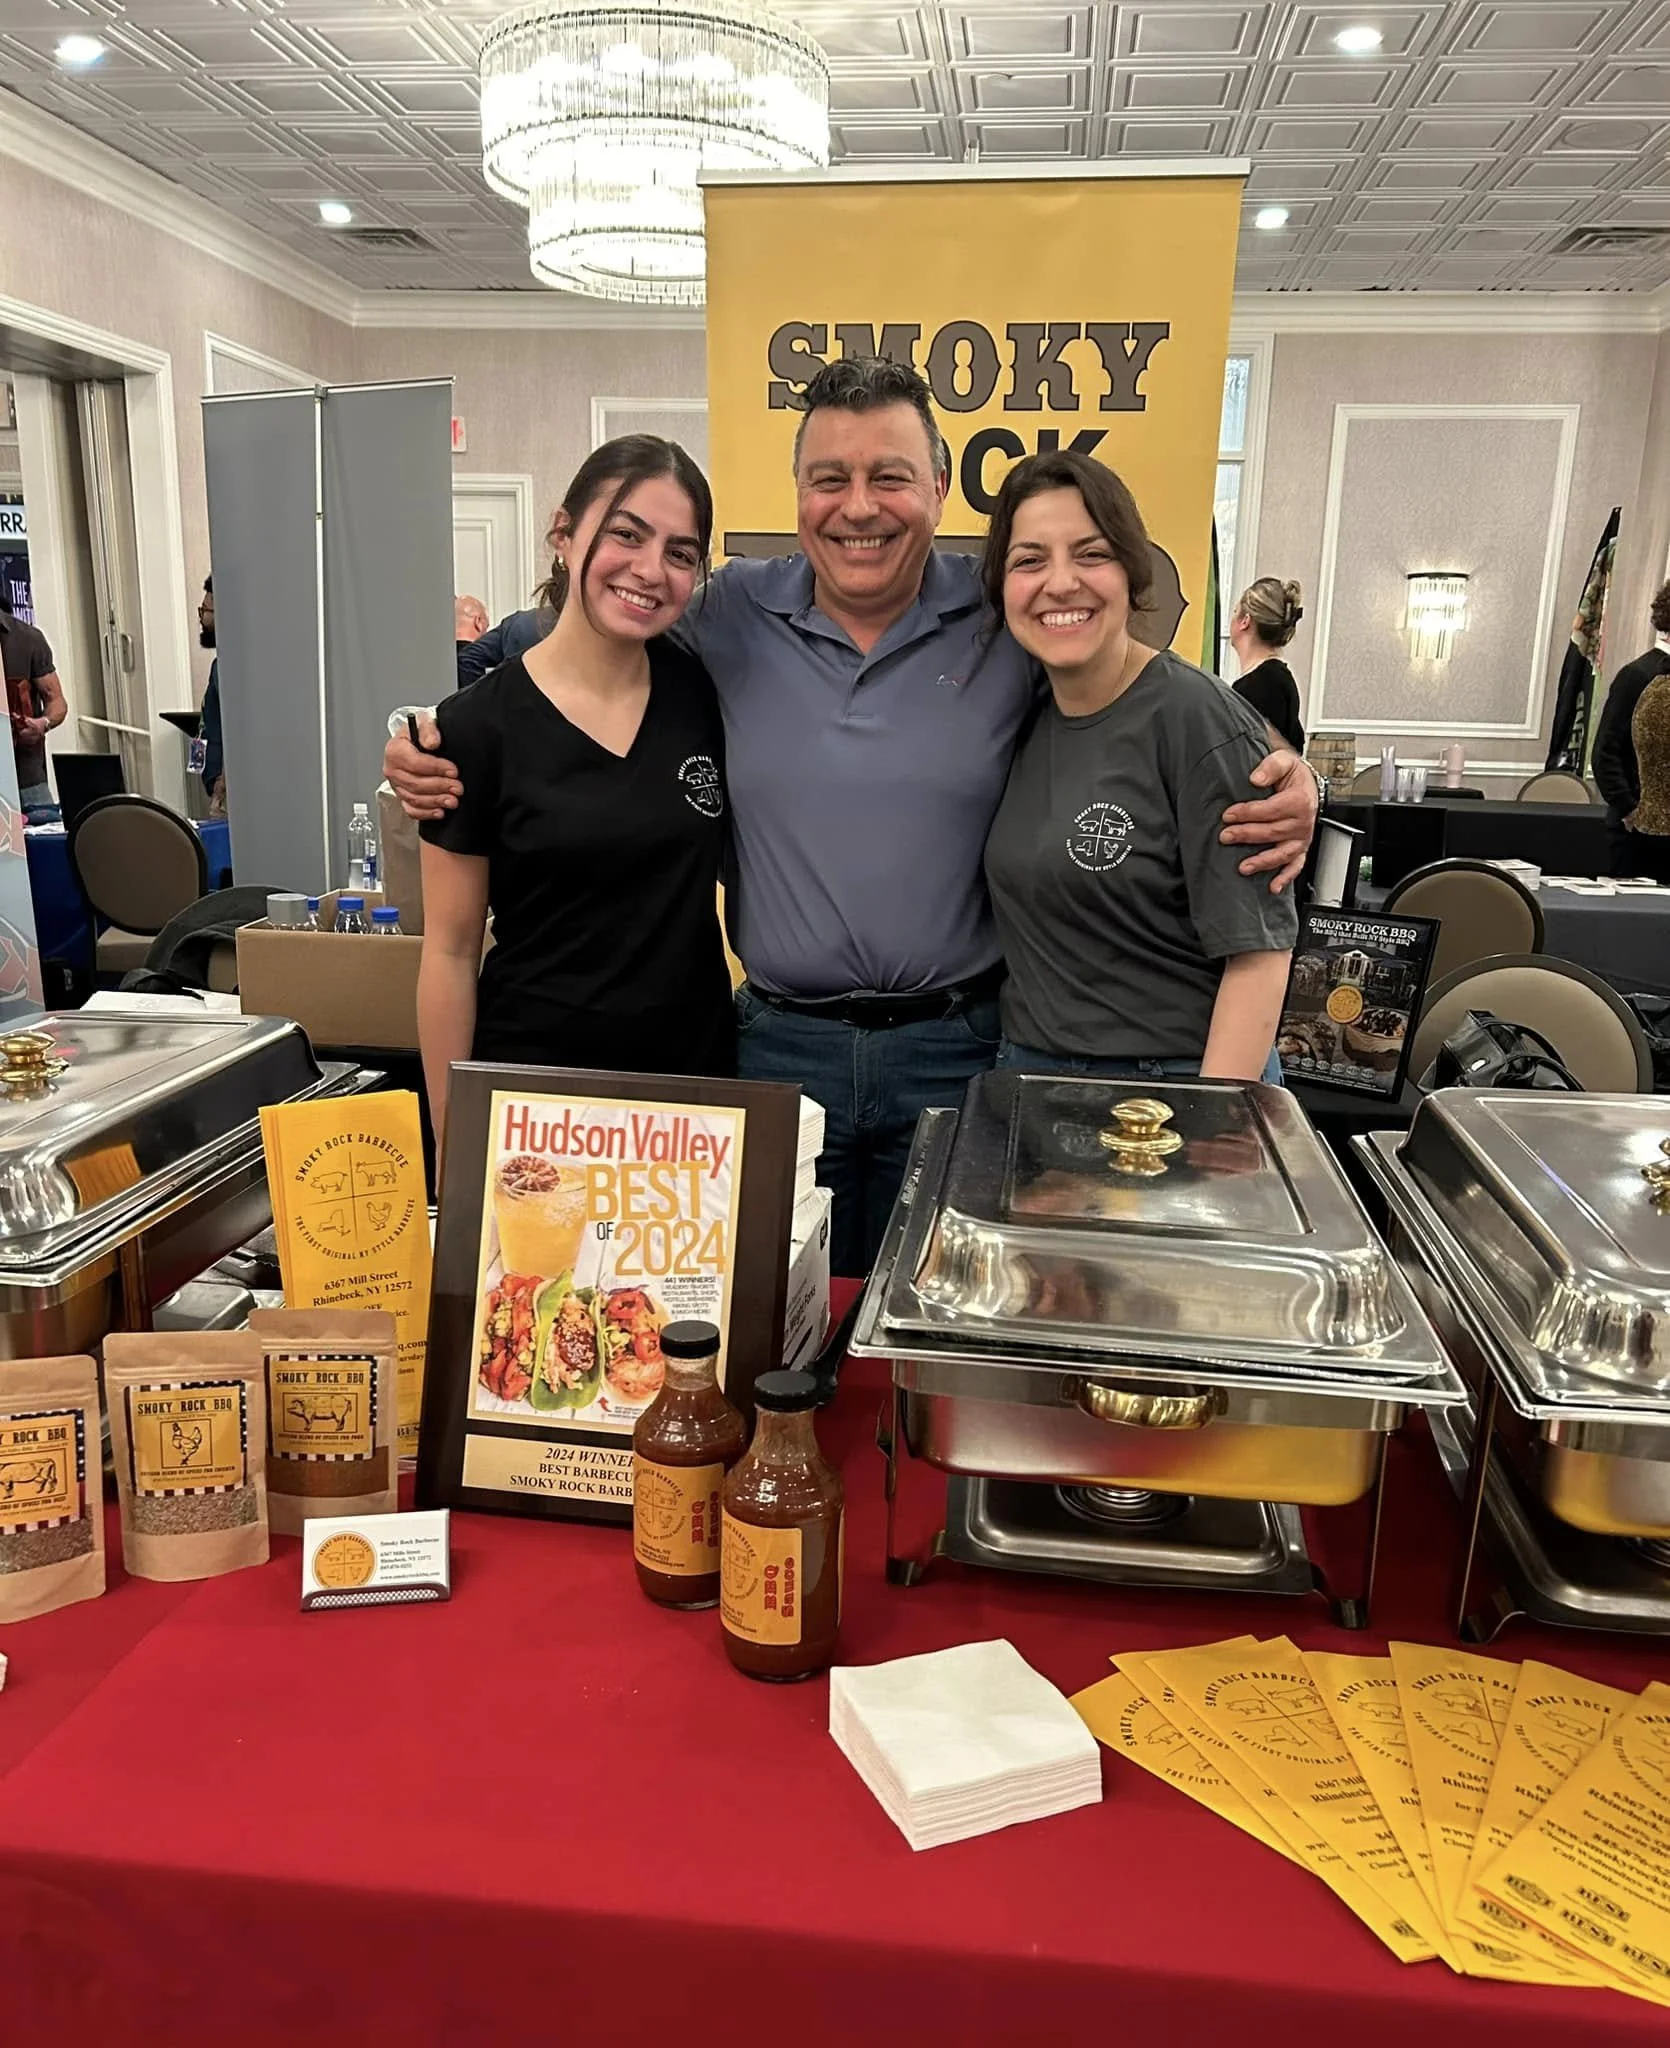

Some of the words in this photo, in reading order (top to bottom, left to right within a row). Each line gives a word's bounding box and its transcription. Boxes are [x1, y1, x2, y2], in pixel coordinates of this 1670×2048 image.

[0, 512, 27, 533] RR
[10, 580, 28, 605] THE
[1309, 917, 1353, 931] SMOKY
[1354, 922, 1389, 936] ROCK
[1390, 927, 1417, 941] BBQ
[504, 1104, 626, 1159] Hudson
[631, 1113, 731, 1179] Valley
[295, 1147, 323, 1182] SMOKY
[325, 1133, 353, 1151] ROCK
[358, 1133, 409, 1169] BARBECUE
[585, 1161, 710, 1221] BEST
[597, 1221, 615, 1241] OF
[614, 1219, 728, 1276] 2024
[324, 1279, 346, 1291] 6367
[348, 1275, 368, 1286] Mill
[369, 1271, 398, 1281] Street
[313, 1291, 364, 1307] Rhinebeck,
[366, 1284, 382, 1295] NY
[385, 1280, 413, 1293] 12572
[276, 1372, 309, 1383] SMOKY
[316, 1372, 340, 1383] ROCK
[347, 1373, 364, 1384] BBQ
[137, 1402, 173, 1415] SMOKY
[180, 1400, 206, 1412] ROCK
[213, 1398, 232, 1410] BBQ
[13, 1430, 39, 1443] ROCK
[47, 1427, 67, 1440] BBQ
[545, 1447, 576, 1460] 2024
[539, 1463, 571, 1476] BEST
[573, 1466, 633, 1482] BARBECU
[510, 1475, 556, 1489] SMOKY
[559, 1480, 596, 1494] ROCK
[598, 1484, 633, 1497] BARB
[764, 1564, 780, 1610] BBQ
[1205, 1682, 1222, 1707] SMOKY
[1217, 1672, 1248, 1686] ROCK
[1251, 1671, 1316, 1688] BARBECU
[1336, 1682, 1364, 1703] SMOKY
[1364, 1680, 1398, 1688] ROCK
[1412, 1674, 1445, 1691] SMOKY
[1448, 1672, 1485, 1683] ROCK
[1124, 1696, 1150, 1715] ROCK
[1572, 1698, 1611, 1714] ROCK
[1120, 1715, 1138, 1747] SMOKY
[1231, 1730, 1249, 1743] THE
[1250, 1741, 1282, 1757] FIRST
[1164, 1767, 1184, 1779] THE
[1188, 1775, 1220, 1785] FIRST
[1310, 1788, 1372, 1803] Rhinebeck
